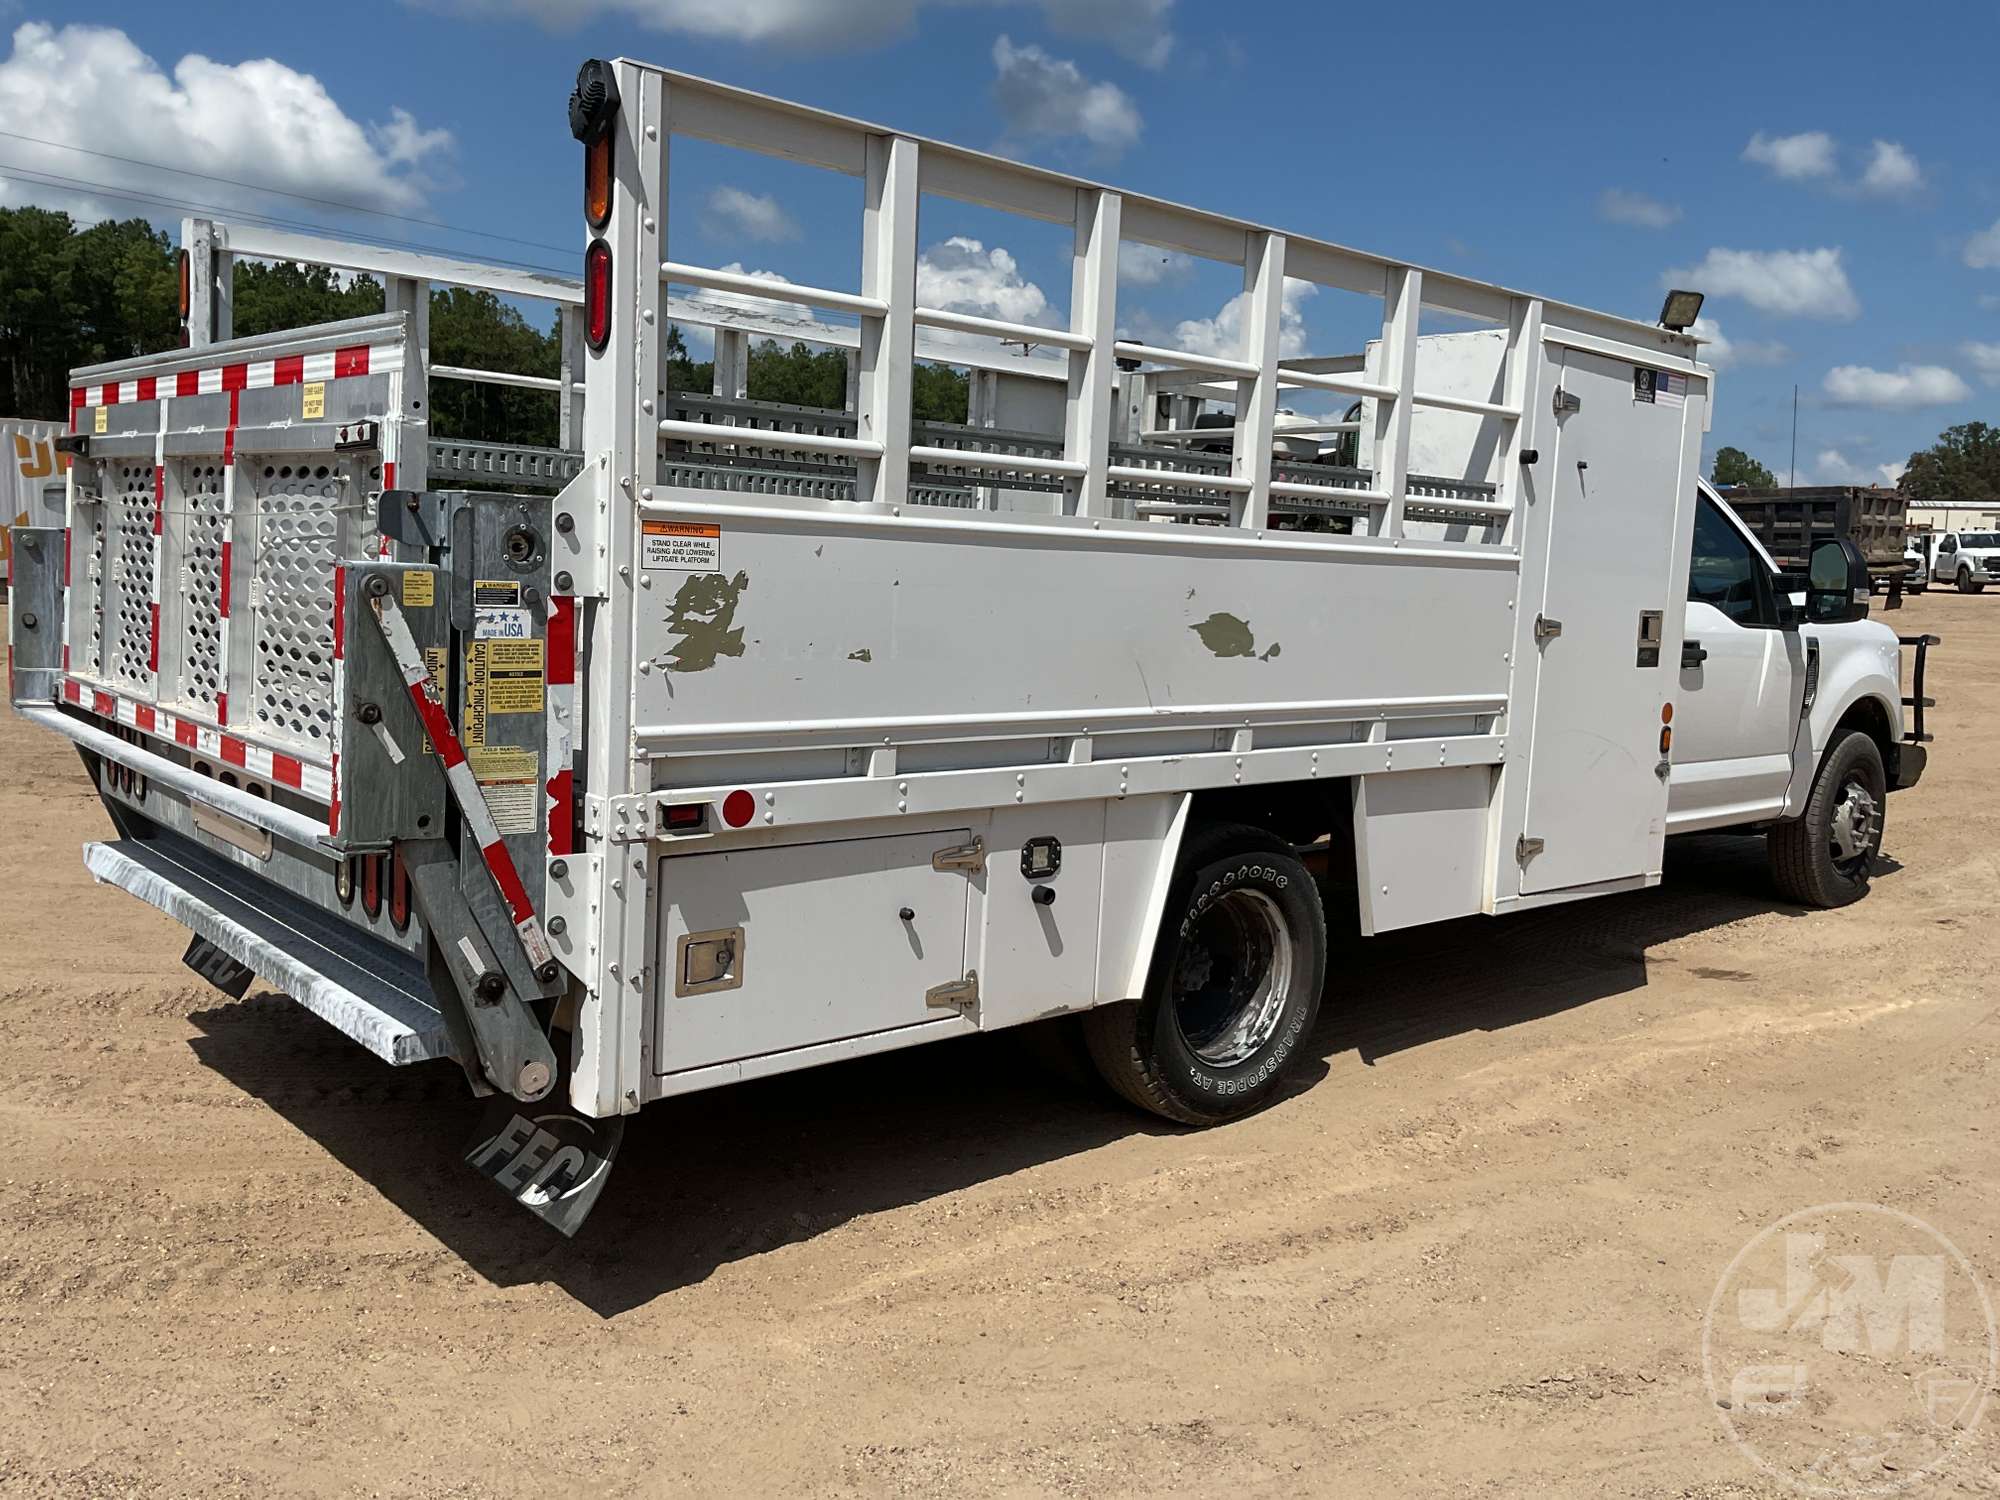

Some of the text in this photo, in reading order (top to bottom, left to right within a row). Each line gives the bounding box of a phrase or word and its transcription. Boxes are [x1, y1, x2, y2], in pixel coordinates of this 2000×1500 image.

[668, 525, 704, 534] WARNING
[646, 547, 716, 557] RAISING AND LOWERING
[680, 556, 710, 564] PLATFORM
[482, 629, 497, 637] MADE
[504, 624, 524, 637] USA
[473, 643, 486, 745] CAUTION: PINCHPOINT
[1216, 1006, 1308, 1095] TRANSFORCE
